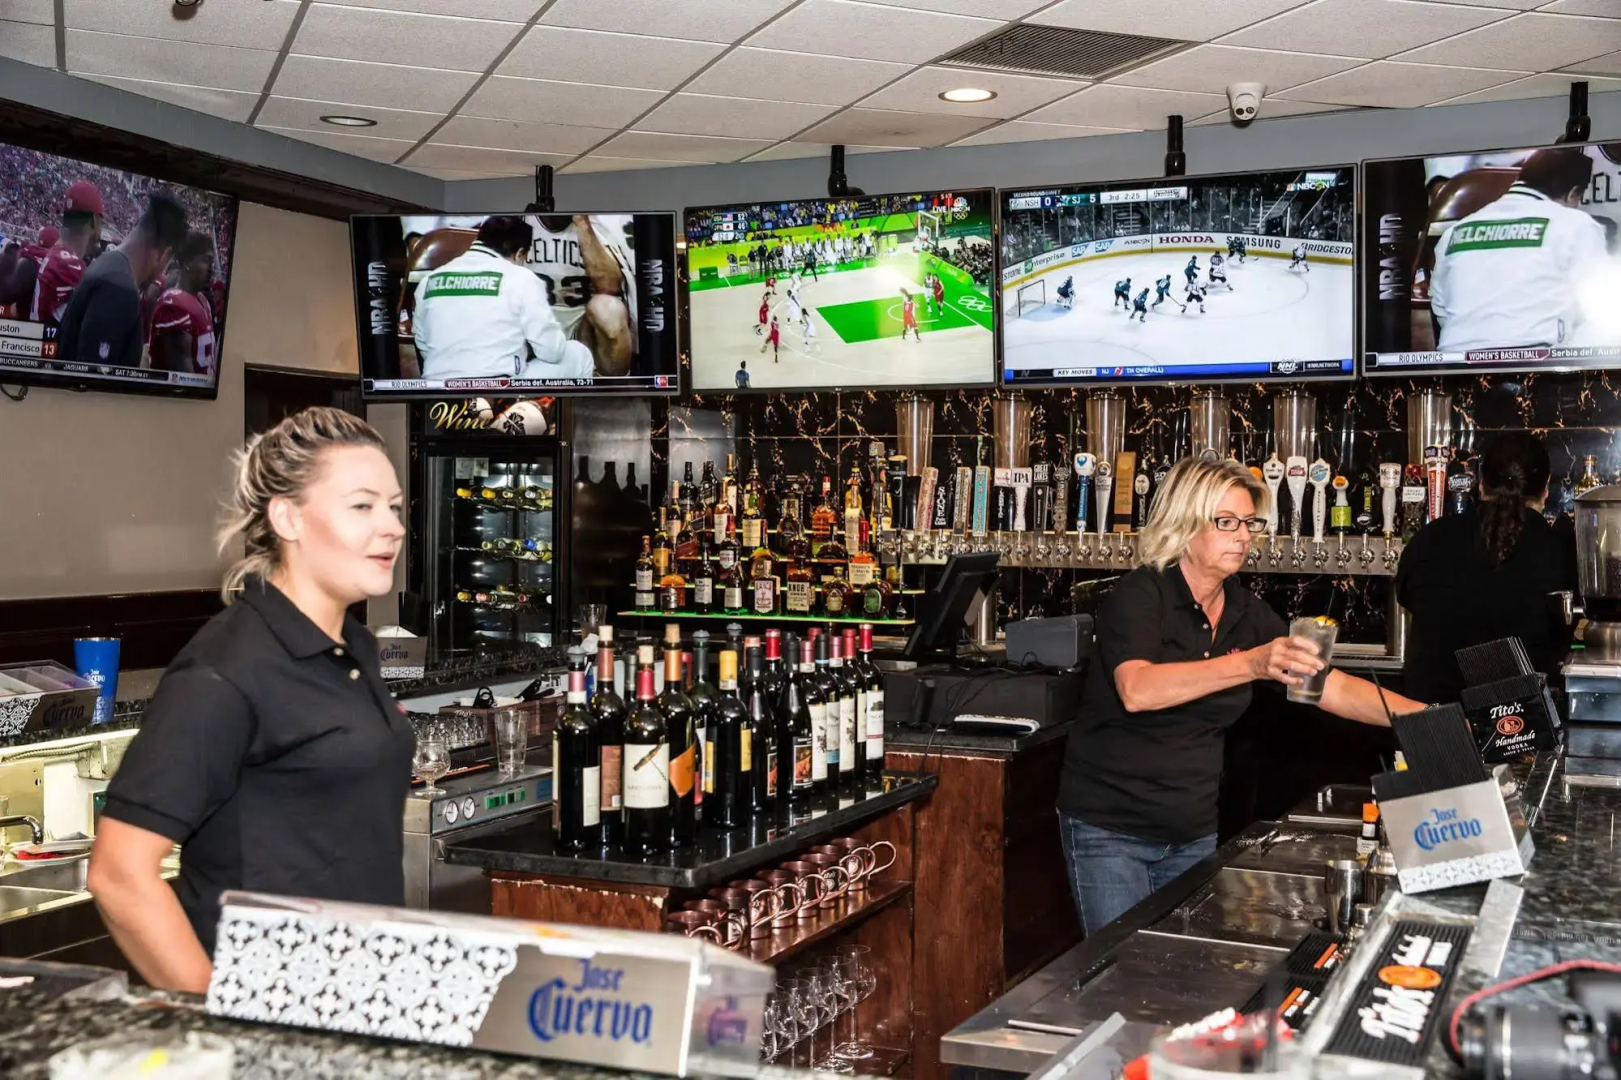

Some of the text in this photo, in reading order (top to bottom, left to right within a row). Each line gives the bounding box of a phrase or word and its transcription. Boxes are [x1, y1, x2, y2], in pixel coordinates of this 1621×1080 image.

[1044, 197, 1052, 206] 0
[1071, 194, 1096, 204] SJ 5
[1158, 235, 1216, 244] HONDA
[1072, 244, 1087, 257] SAP
[1095, 240, 1111, 252] SAP
[1300, 242, 1353, 255] BRIDGESTO
[46, 327, 57, 338] 17
[1, 340, 55, 355] Francisco 13
[1399, 353, 1443, 362] RIO OLYMPICS
[1468, 350, 1540, 360] WOMEN'S BASKETBALL
[1551, 349, 1578, 358] Serbia
[447, 380, 502, 388] WOMEN'S BASKETBALL
[510, 379, 532, 387] Serbia
[532, 379, 543, 387] def.
[545, 379, 576, 387] Australia,
[429, 401, 492, 430] Wine
[1033, 464, 1049, 472] GREAT
[1014, 472, 1029, 483] IPA
[1033, 472, 1049, 481] LAKES
[788, 583, 805, 592] KNOB
[380, 649, 409, 662] Cuervo
[1489, 702, 1522, 720] Tito's
[1495, 730, 1536, 748] Handmade
[1507, 742, 1528, 751] VODKA
[1430, 808, 1457, 826] Jose
[1414, 818, 1483, 851] Cuervo
[573, 957, 625, 993] Jose
[527, 976, 654, 1043] Cuervo
